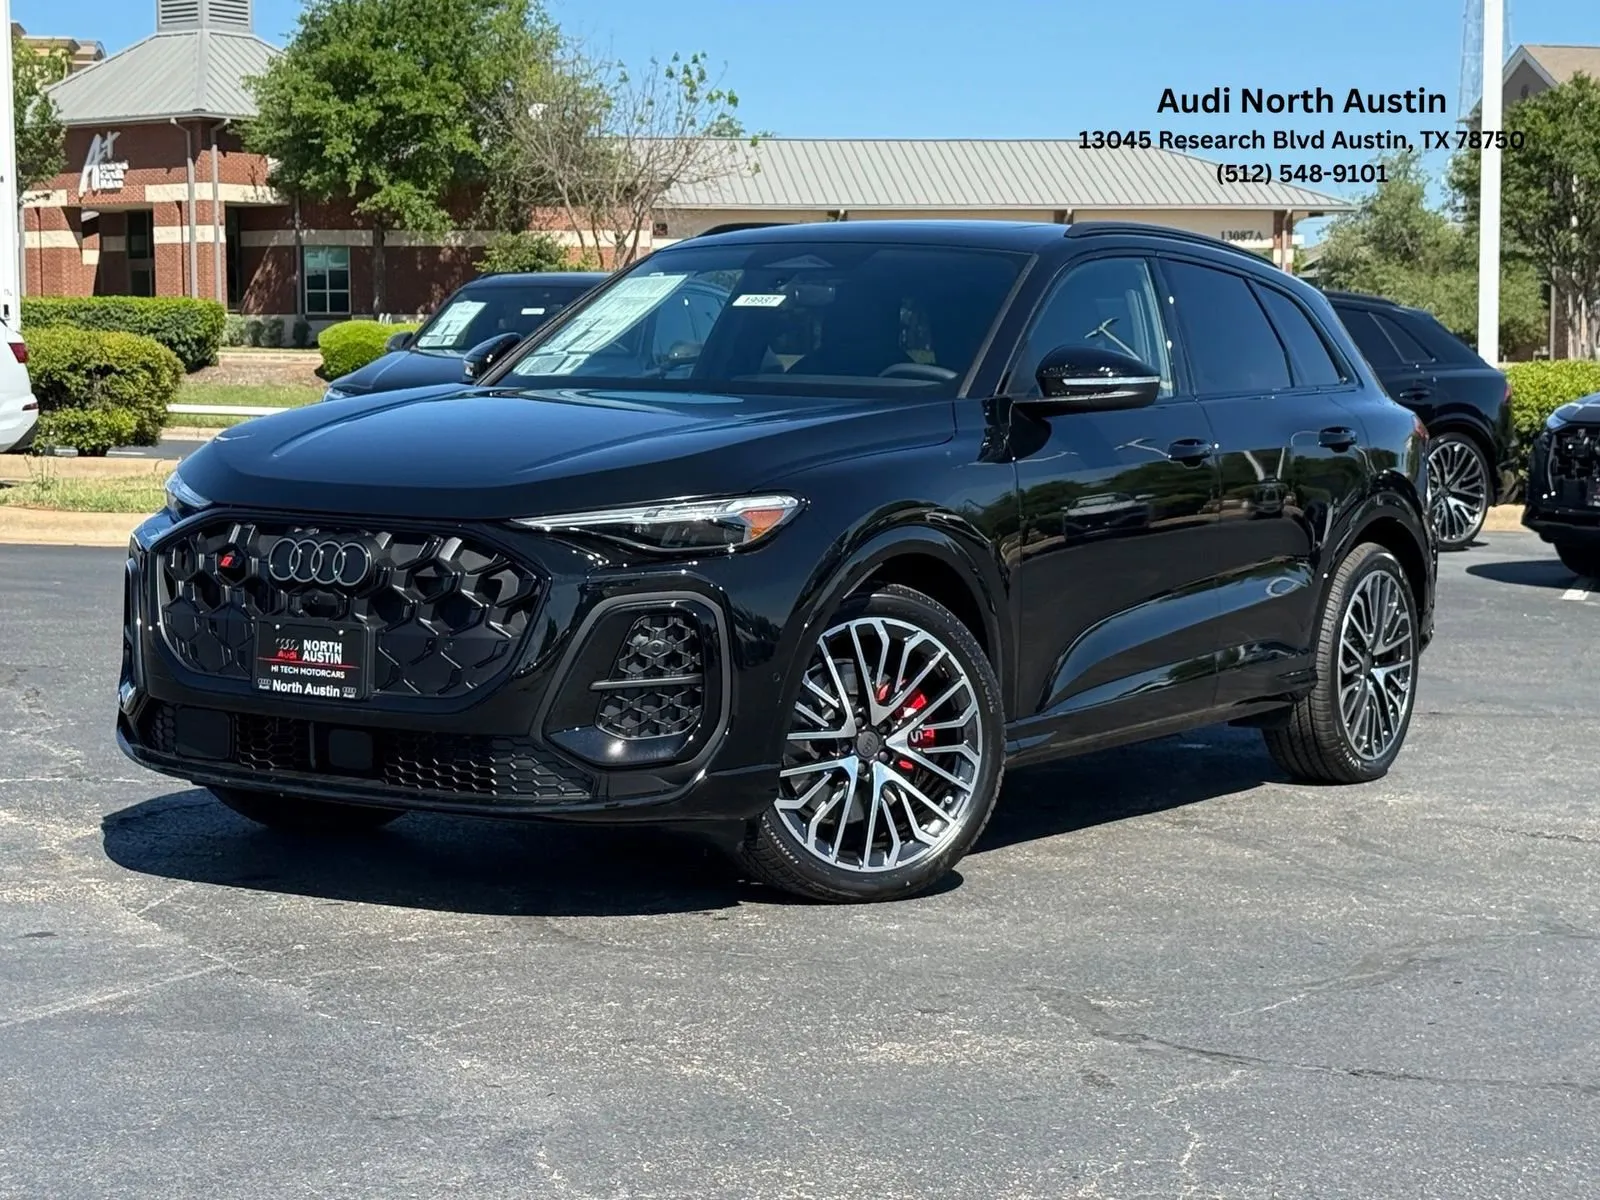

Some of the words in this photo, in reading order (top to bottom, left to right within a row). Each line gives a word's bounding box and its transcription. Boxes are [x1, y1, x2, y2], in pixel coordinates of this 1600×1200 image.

[303, 639, 342, 654] NORTH
[278, 650, 297, 659] Audi
[302, 650, 342, 664] AUSTIN
[271, 665, 279, 673] HI
[280, 665, 299, 674] TECH
[300, 667, 345, 679] MOTORCARS
[272, 679, 302, 694] North
[304, 682, 340, 698] Austin
